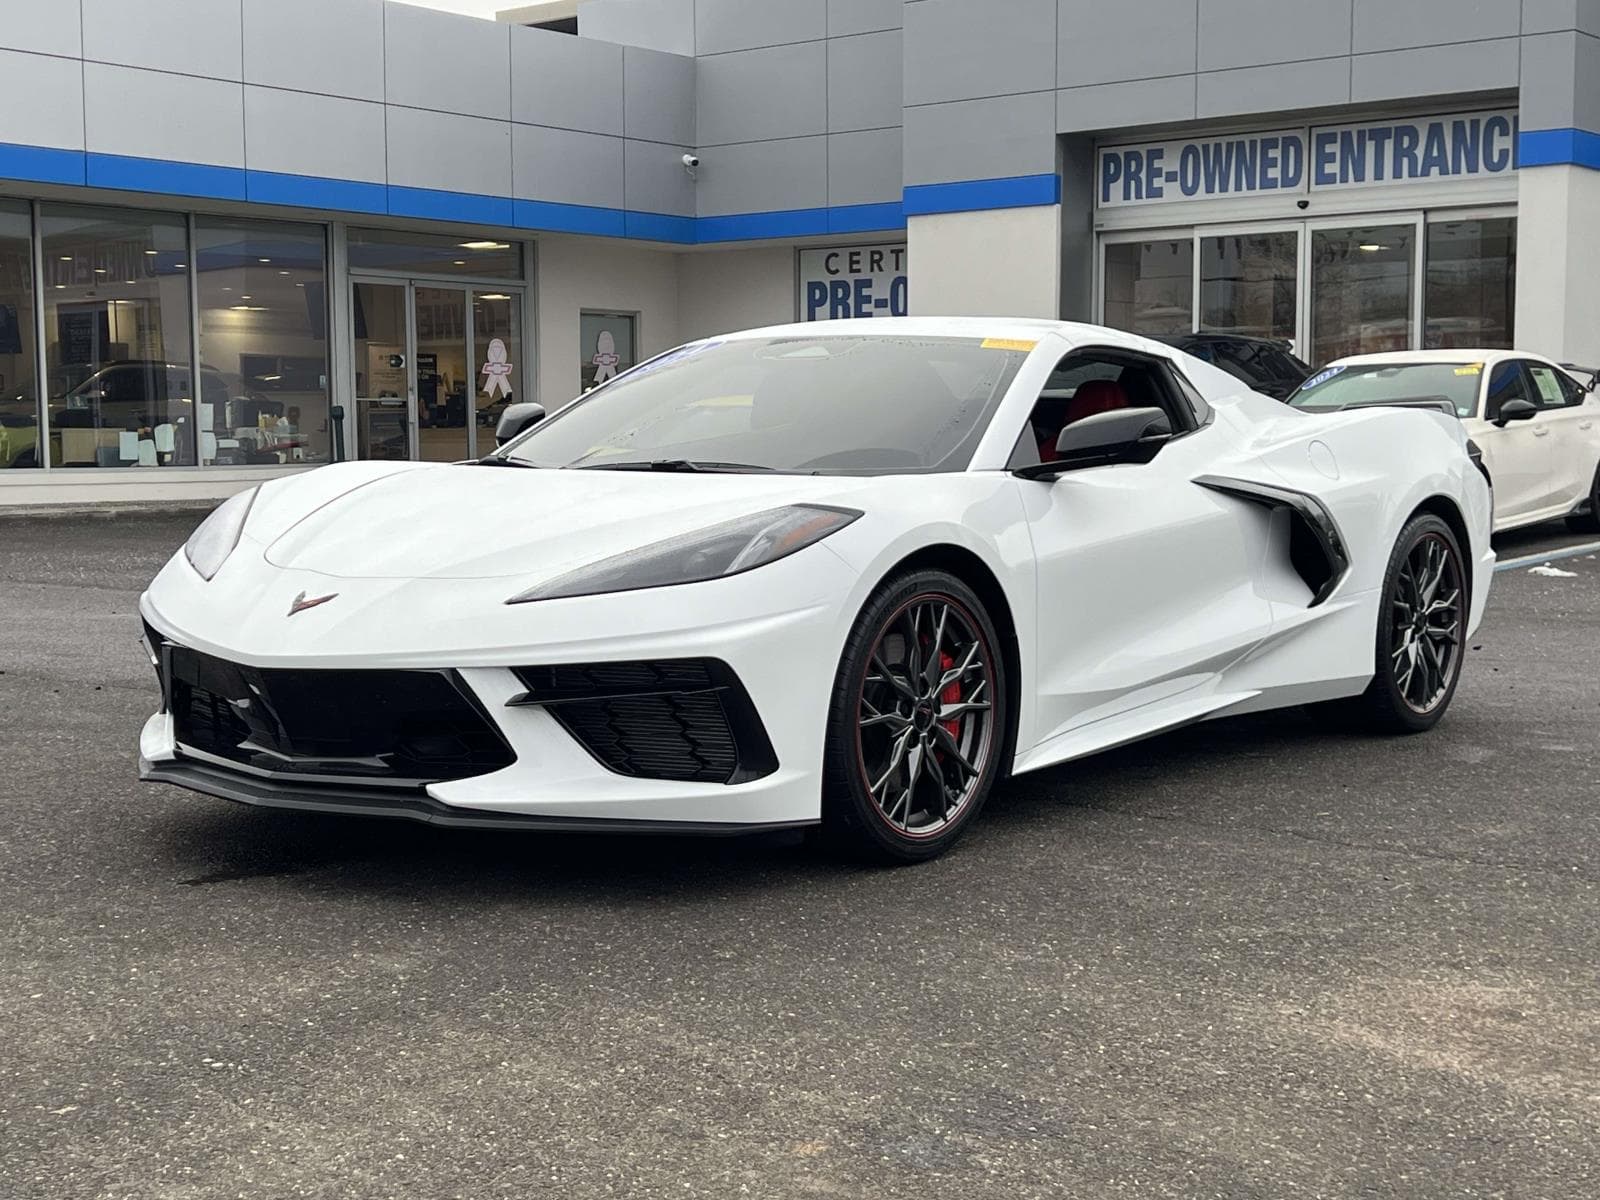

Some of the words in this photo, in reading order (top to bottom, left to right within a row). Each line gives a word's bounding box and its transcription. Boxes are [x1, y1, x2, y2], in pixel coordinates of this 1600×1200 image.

[1102, 135, 1304, 203] PRE-OWNED
[825, 248, 905, 275] CERT
[806, 275, 908, 322] PRE-O
